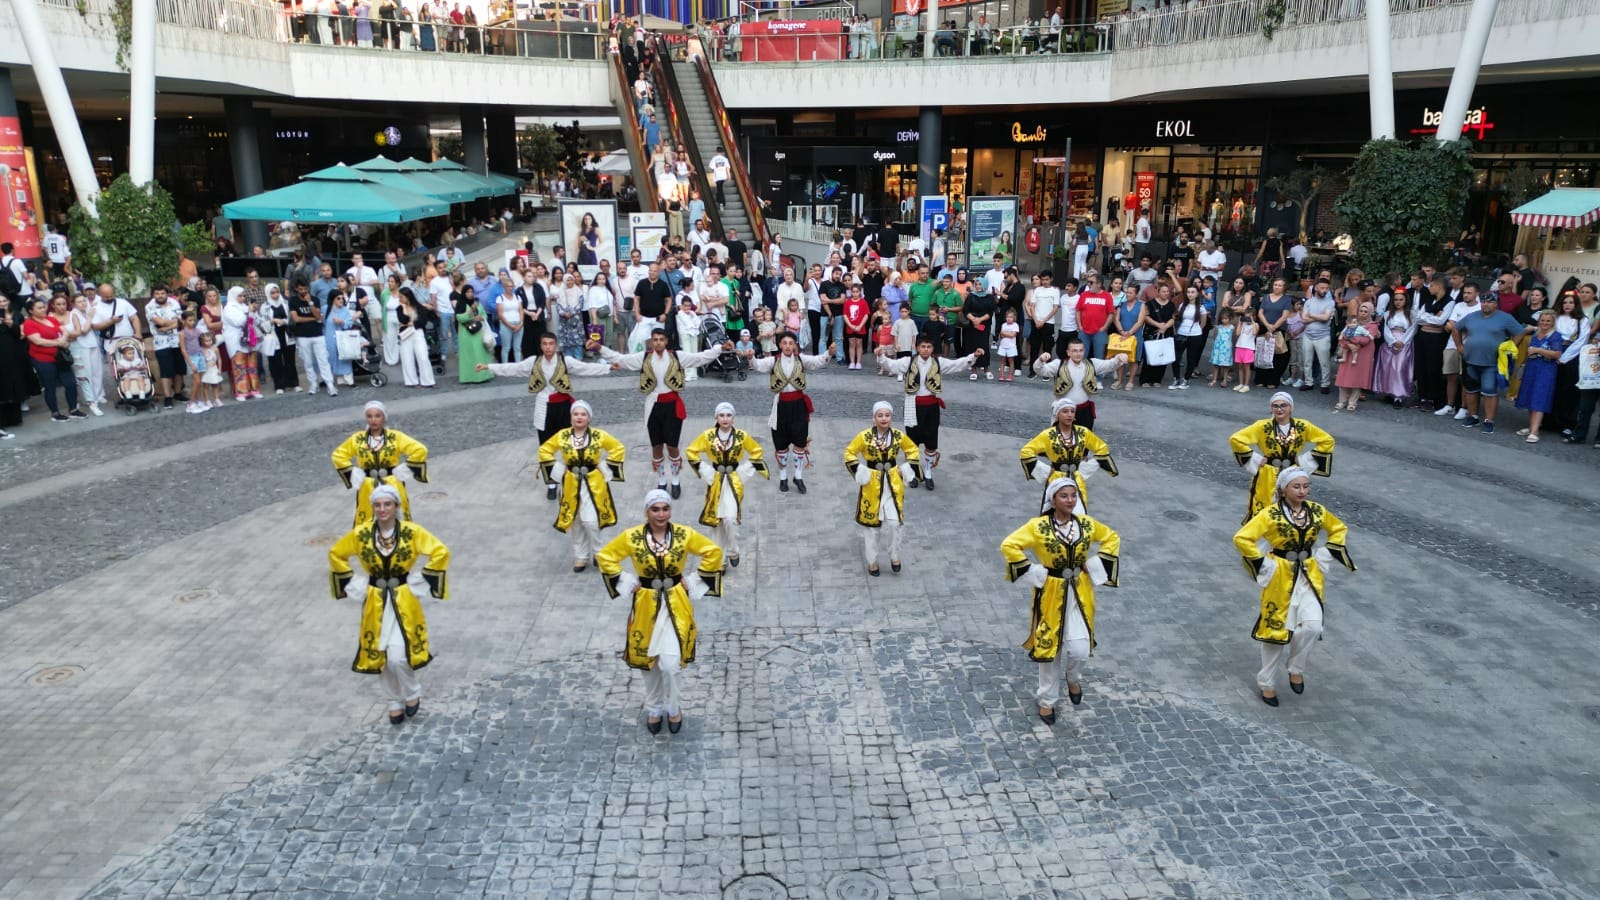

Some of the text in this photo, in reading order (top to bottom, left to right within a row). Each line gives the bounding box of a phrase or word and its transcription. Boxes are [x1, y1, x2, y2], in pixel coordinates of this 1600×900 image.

[1012, 122, 1047, 142] Bambi
[1156, 120, 1195, 137] EKOL
[873, 150, 896, 162] dyson
[933, 214, 946, 229] P
[50, 242, 58, 254] 8
